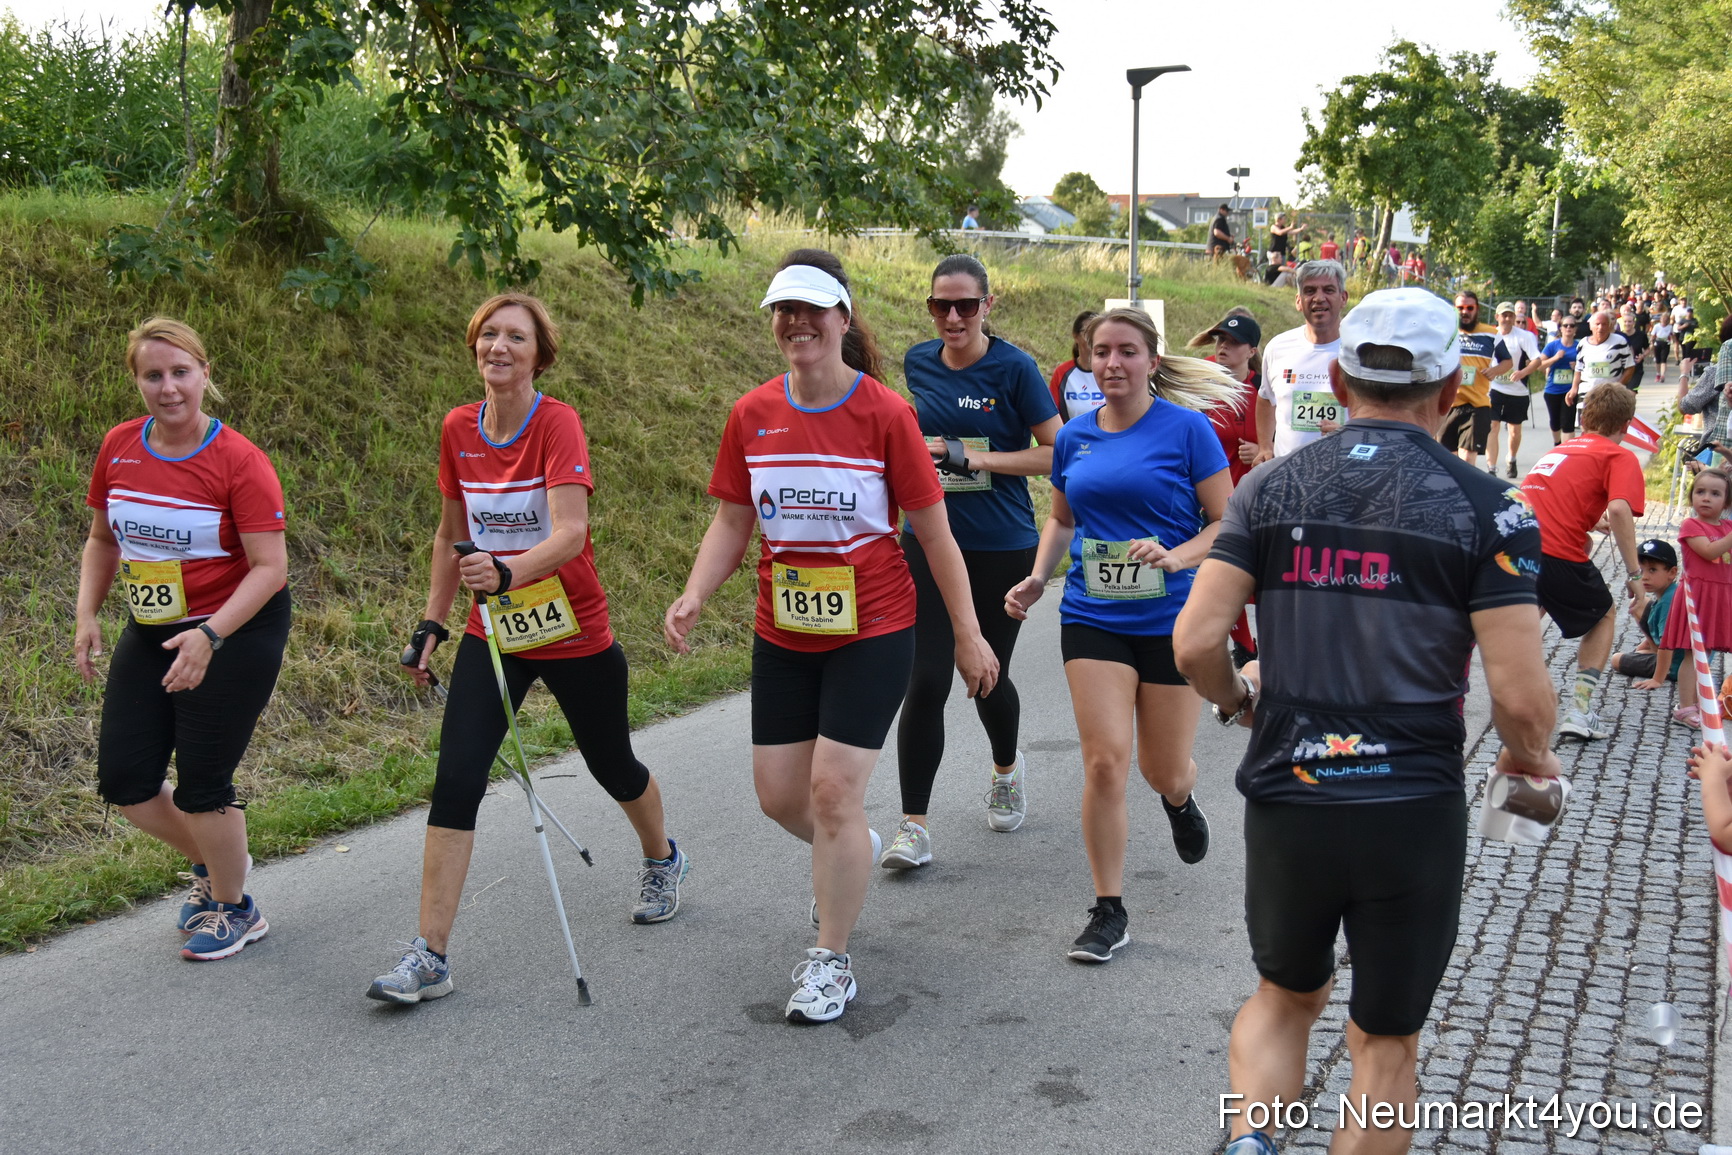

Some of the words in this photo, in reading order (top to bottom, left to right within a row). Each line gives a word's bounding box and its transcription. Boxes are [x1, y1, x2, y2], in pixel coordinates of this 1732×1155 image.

[958, 395, 981, 409] vhs
[1297, 405, 1336, 421] 2149
[780, 488, 856, 511] Petry
[480, 511, 538, 524] Petry
[125, 520, 191, 545] Petry
[1099, 562, 1141, 583] 577
[1307, 565, 1402, 588] Schrauben
[125, 581, 173, 606] 828
[782, 589, 843, 616] 1819
[500, 601, 562, 636] 1814
[539, 622, 566, 635] Theresa
[791, 614, 809, 622] Fuchs
[1316, 763, 1390, 777] NIJHUIS
